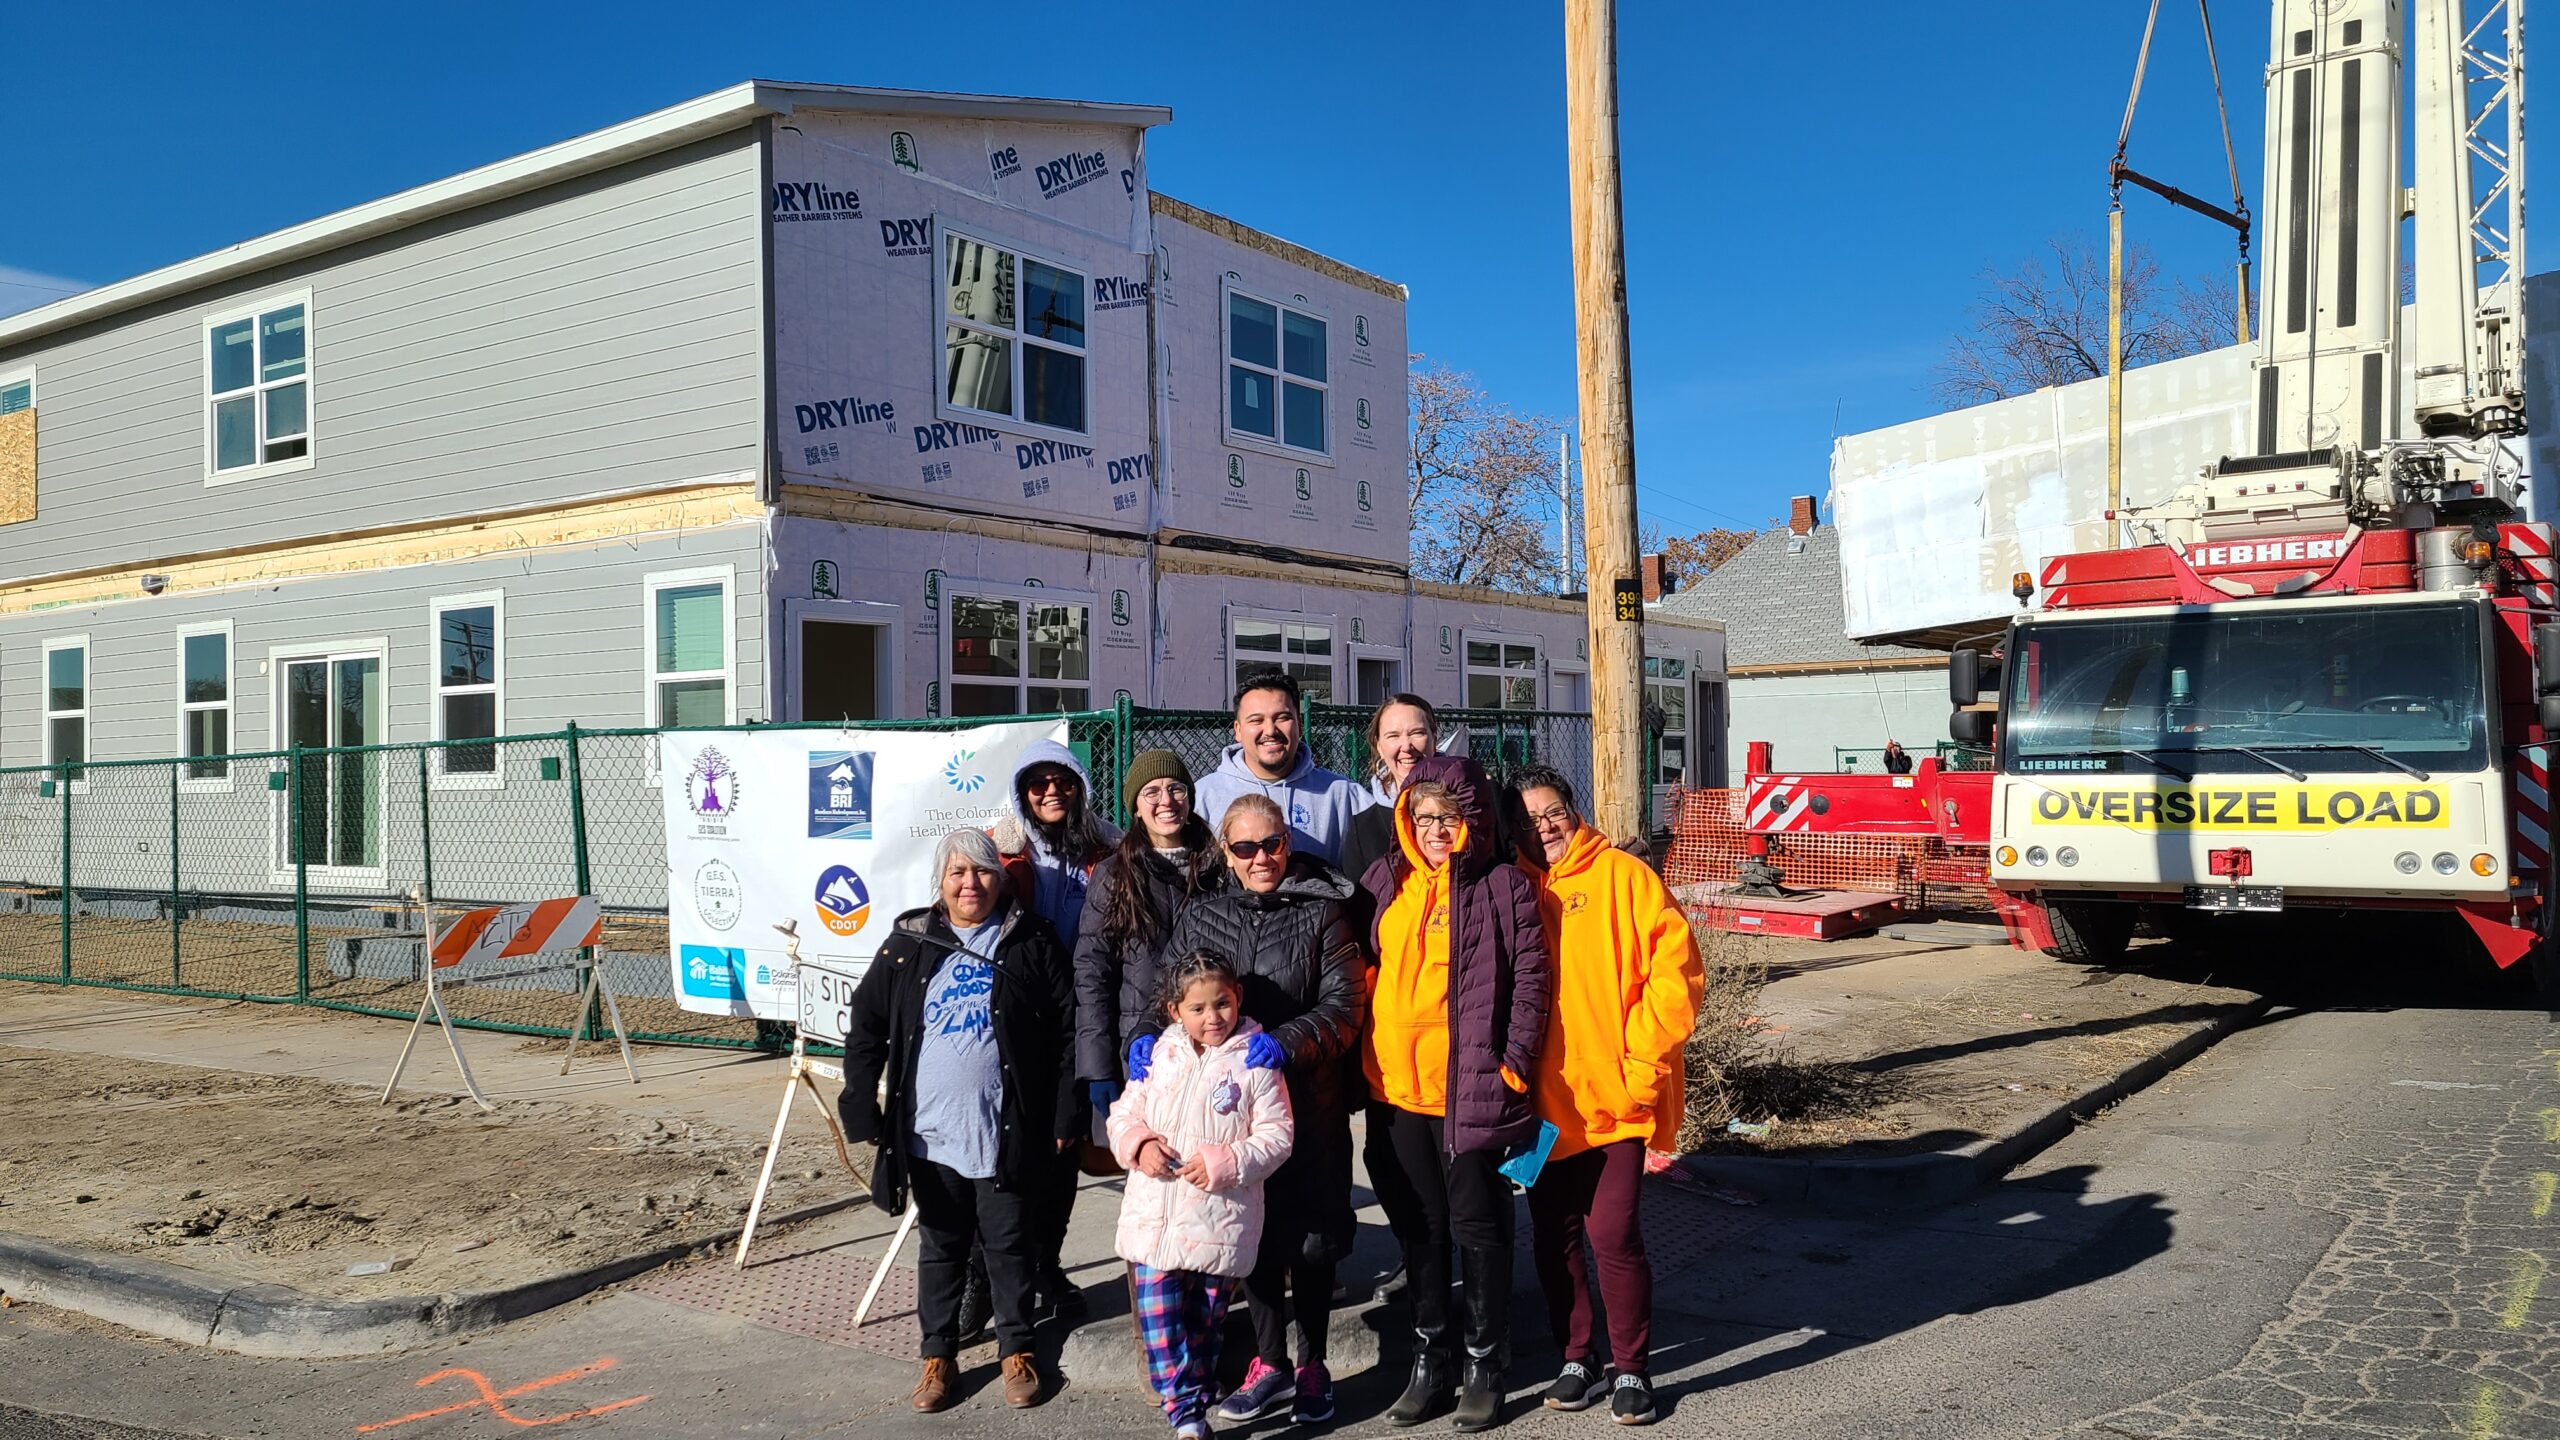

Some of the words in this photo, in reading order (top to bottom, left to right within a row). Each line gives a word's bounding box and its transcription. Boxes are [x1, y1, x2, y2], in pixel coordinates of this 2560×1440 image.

[1035, 151, 1106, 192] DRYline
[1043, 184, 1069, 200] WEATHER
[1068, 175, 1089, 190] BARRIER
[1088, 167, 1109, 182] SYSTEMS
[801, 213, 832, 222] BARRIER
[833, 211, 863, 220] SYSTEMS
[886, 248, 918, 257] WEATHER
[1110, 300, 1131, 310] BARRIER
[795, 397, 894, 434] DRYline
[886, 420, 897, 434] W
[2019, 759, 2107, 770] LIEBHERR
[830, 794, 852, 808] BRI
[2038, 791, 2277, 824] OVERSIZE
[2297, 789, 2441, 823] LOAD
[925, 808, 953, 821] The
[700, 886, 735, 898] TIERRA
[829, 919, 858, 930] CDOT
